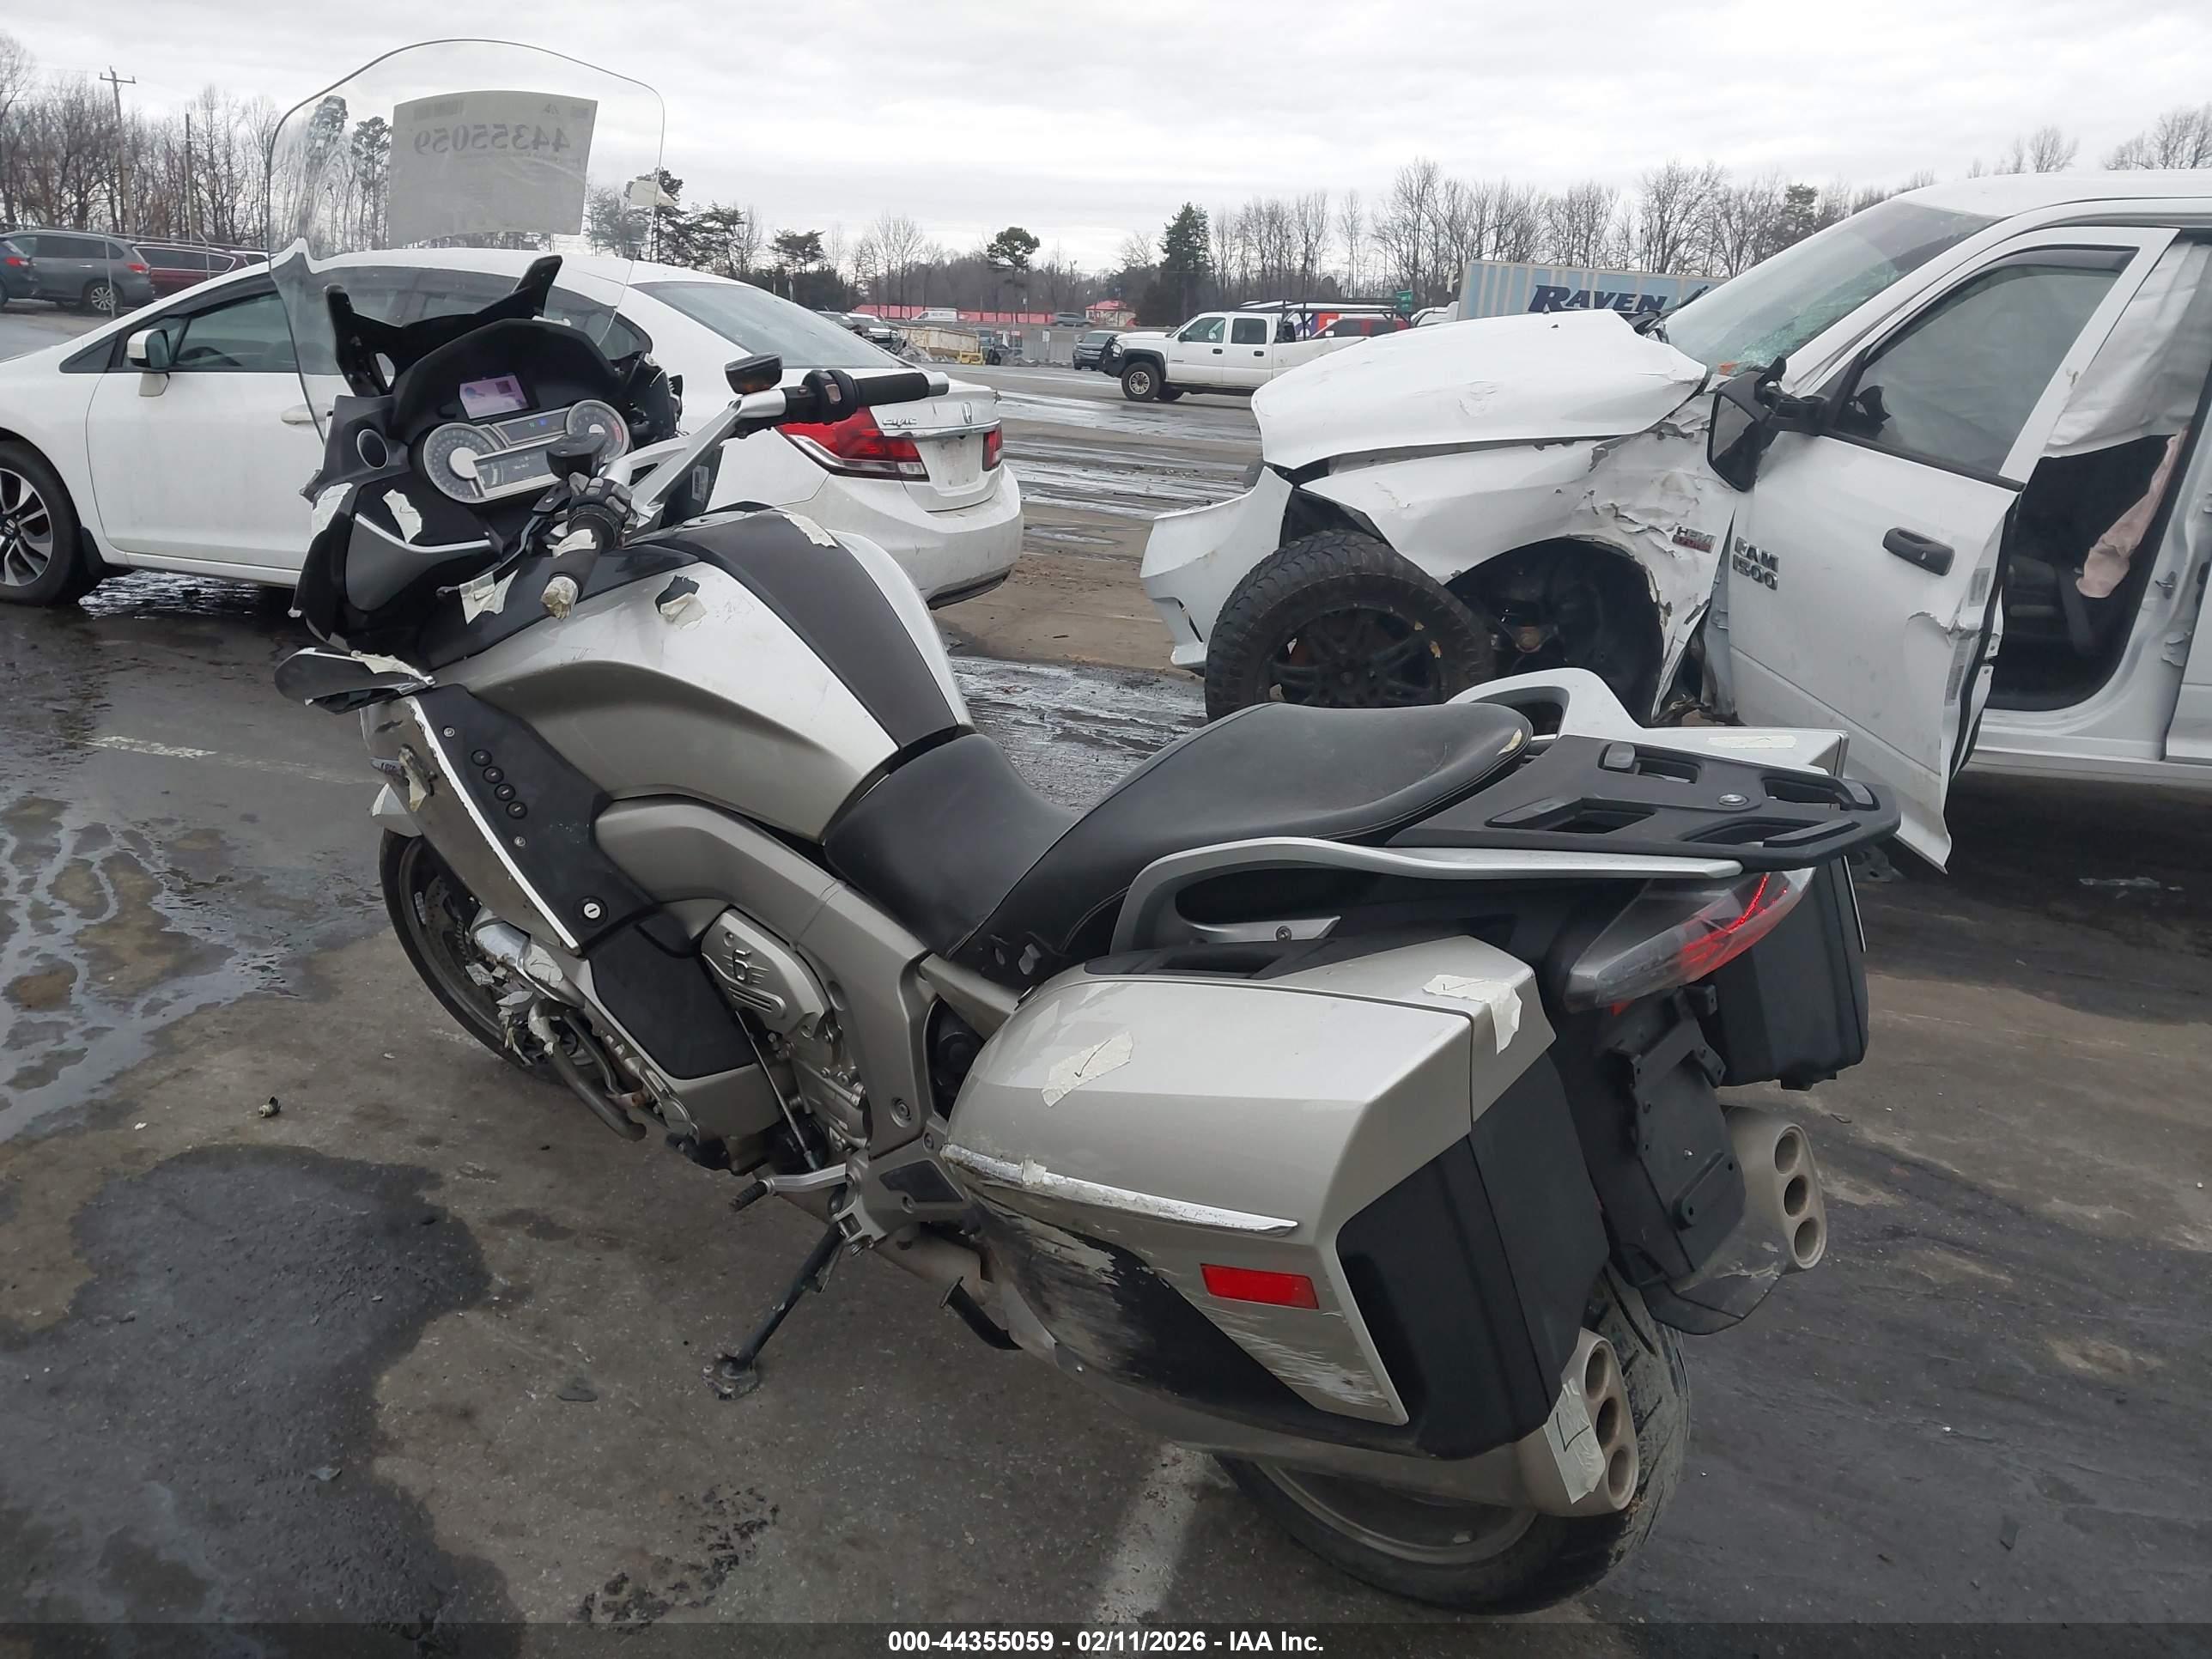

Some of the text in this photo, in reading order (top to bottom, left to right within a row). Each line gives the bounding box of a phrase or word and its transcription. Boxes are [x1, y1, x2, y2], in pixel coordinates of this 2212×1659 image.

[1528, 284, 1668, 313] RAVEN
[1732, 553, 1778, 591] 1500
[1735, 536, 1779, 573] RAM
